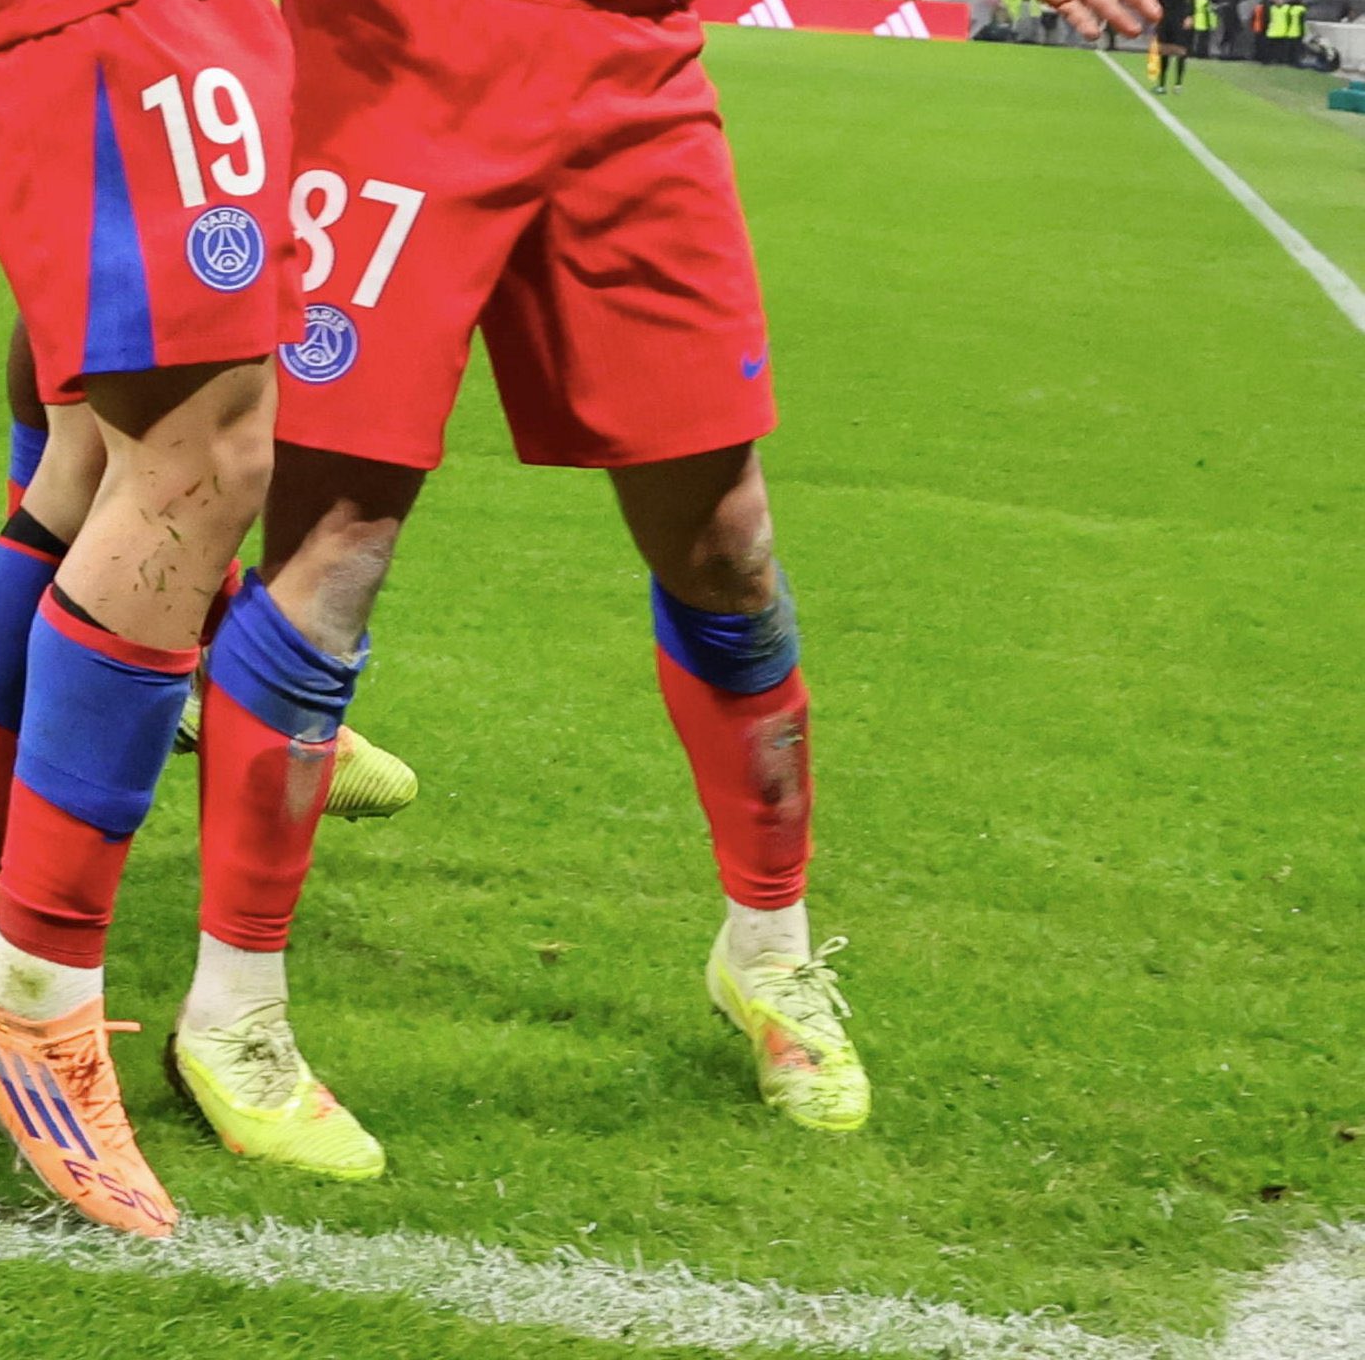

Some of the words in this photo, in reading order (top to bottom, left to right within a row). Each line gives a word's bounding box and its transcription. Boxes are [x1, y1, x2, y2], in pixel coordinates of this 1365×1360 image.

[141, 67, 267, 208] 19
[198, 211, 250, 233] PARIS
[288, 169, 427, 308] 87
[304, 309, 349, 332] ARIS
